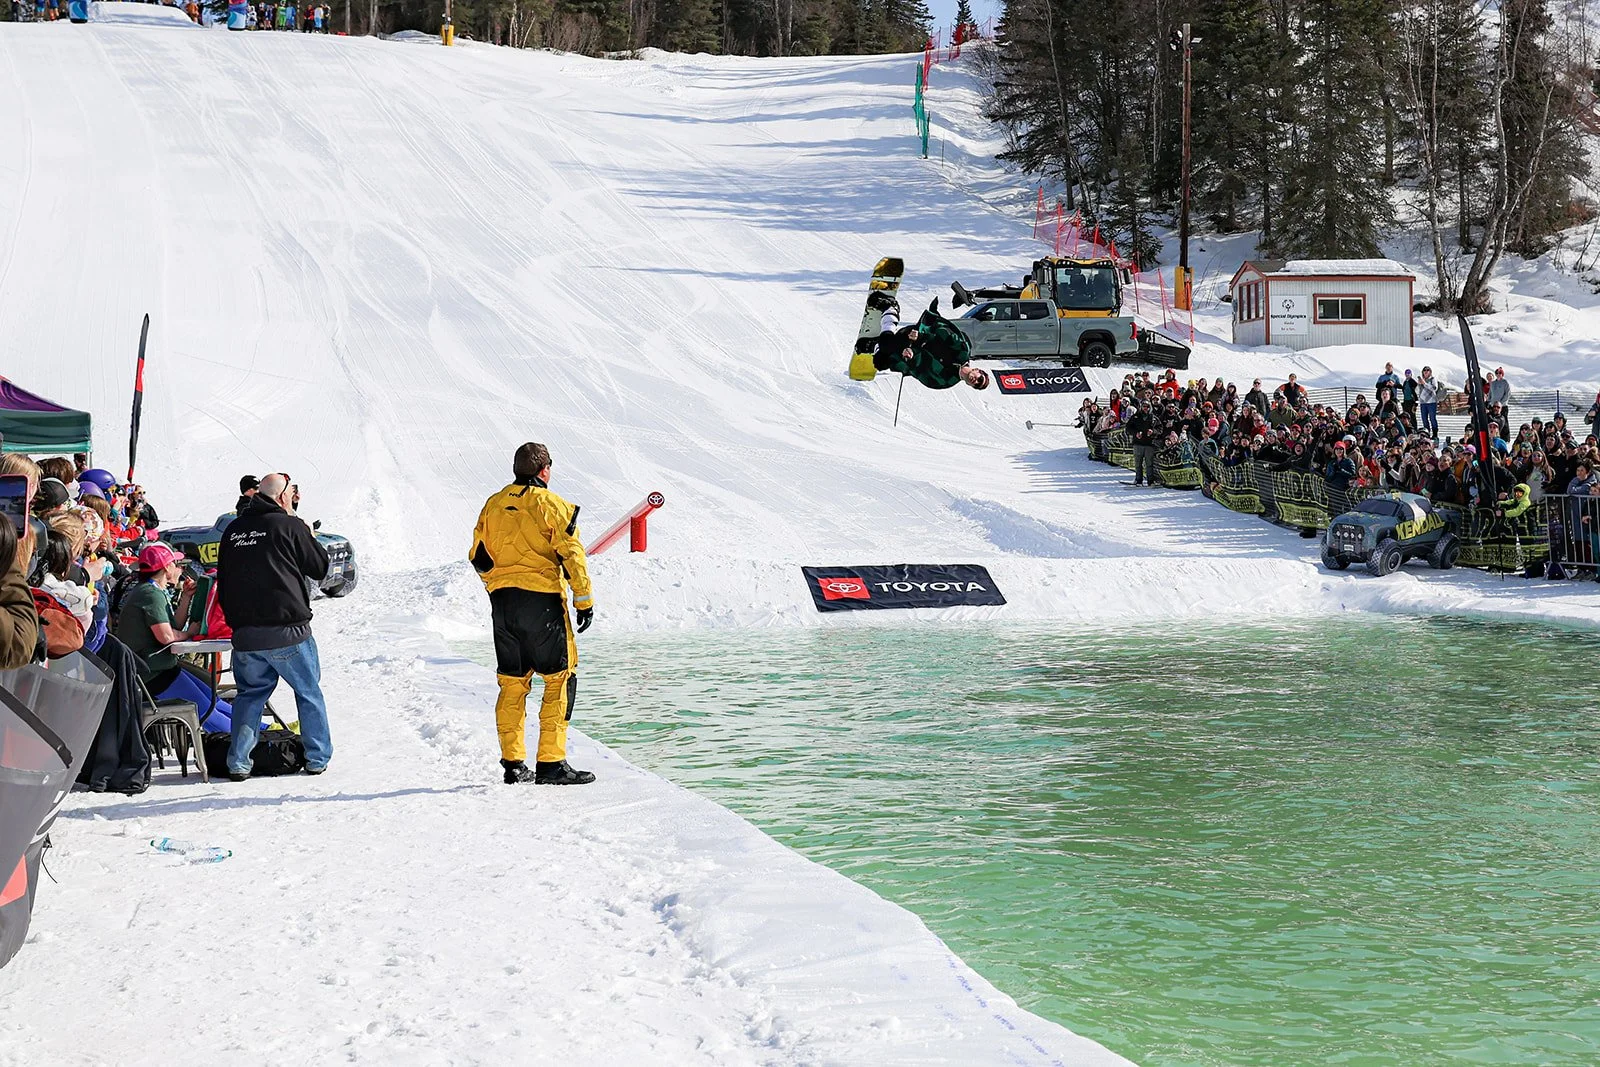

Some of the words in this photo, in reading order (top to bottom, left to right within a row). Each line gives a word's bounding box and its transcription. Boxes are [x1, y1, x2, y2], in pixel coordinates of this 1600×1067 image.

[1027, 376, 1081, 385] TOYOTA
[1395, 512, 1445, 540] KENDALL
[230, 532, 247, 541] Eagle
[249, 530, 267, 538] River
[234, 538, 257, 547] Alaska
[197, 542, 220, 564] KE
[875, 581, 986, 593] TOYOTA
